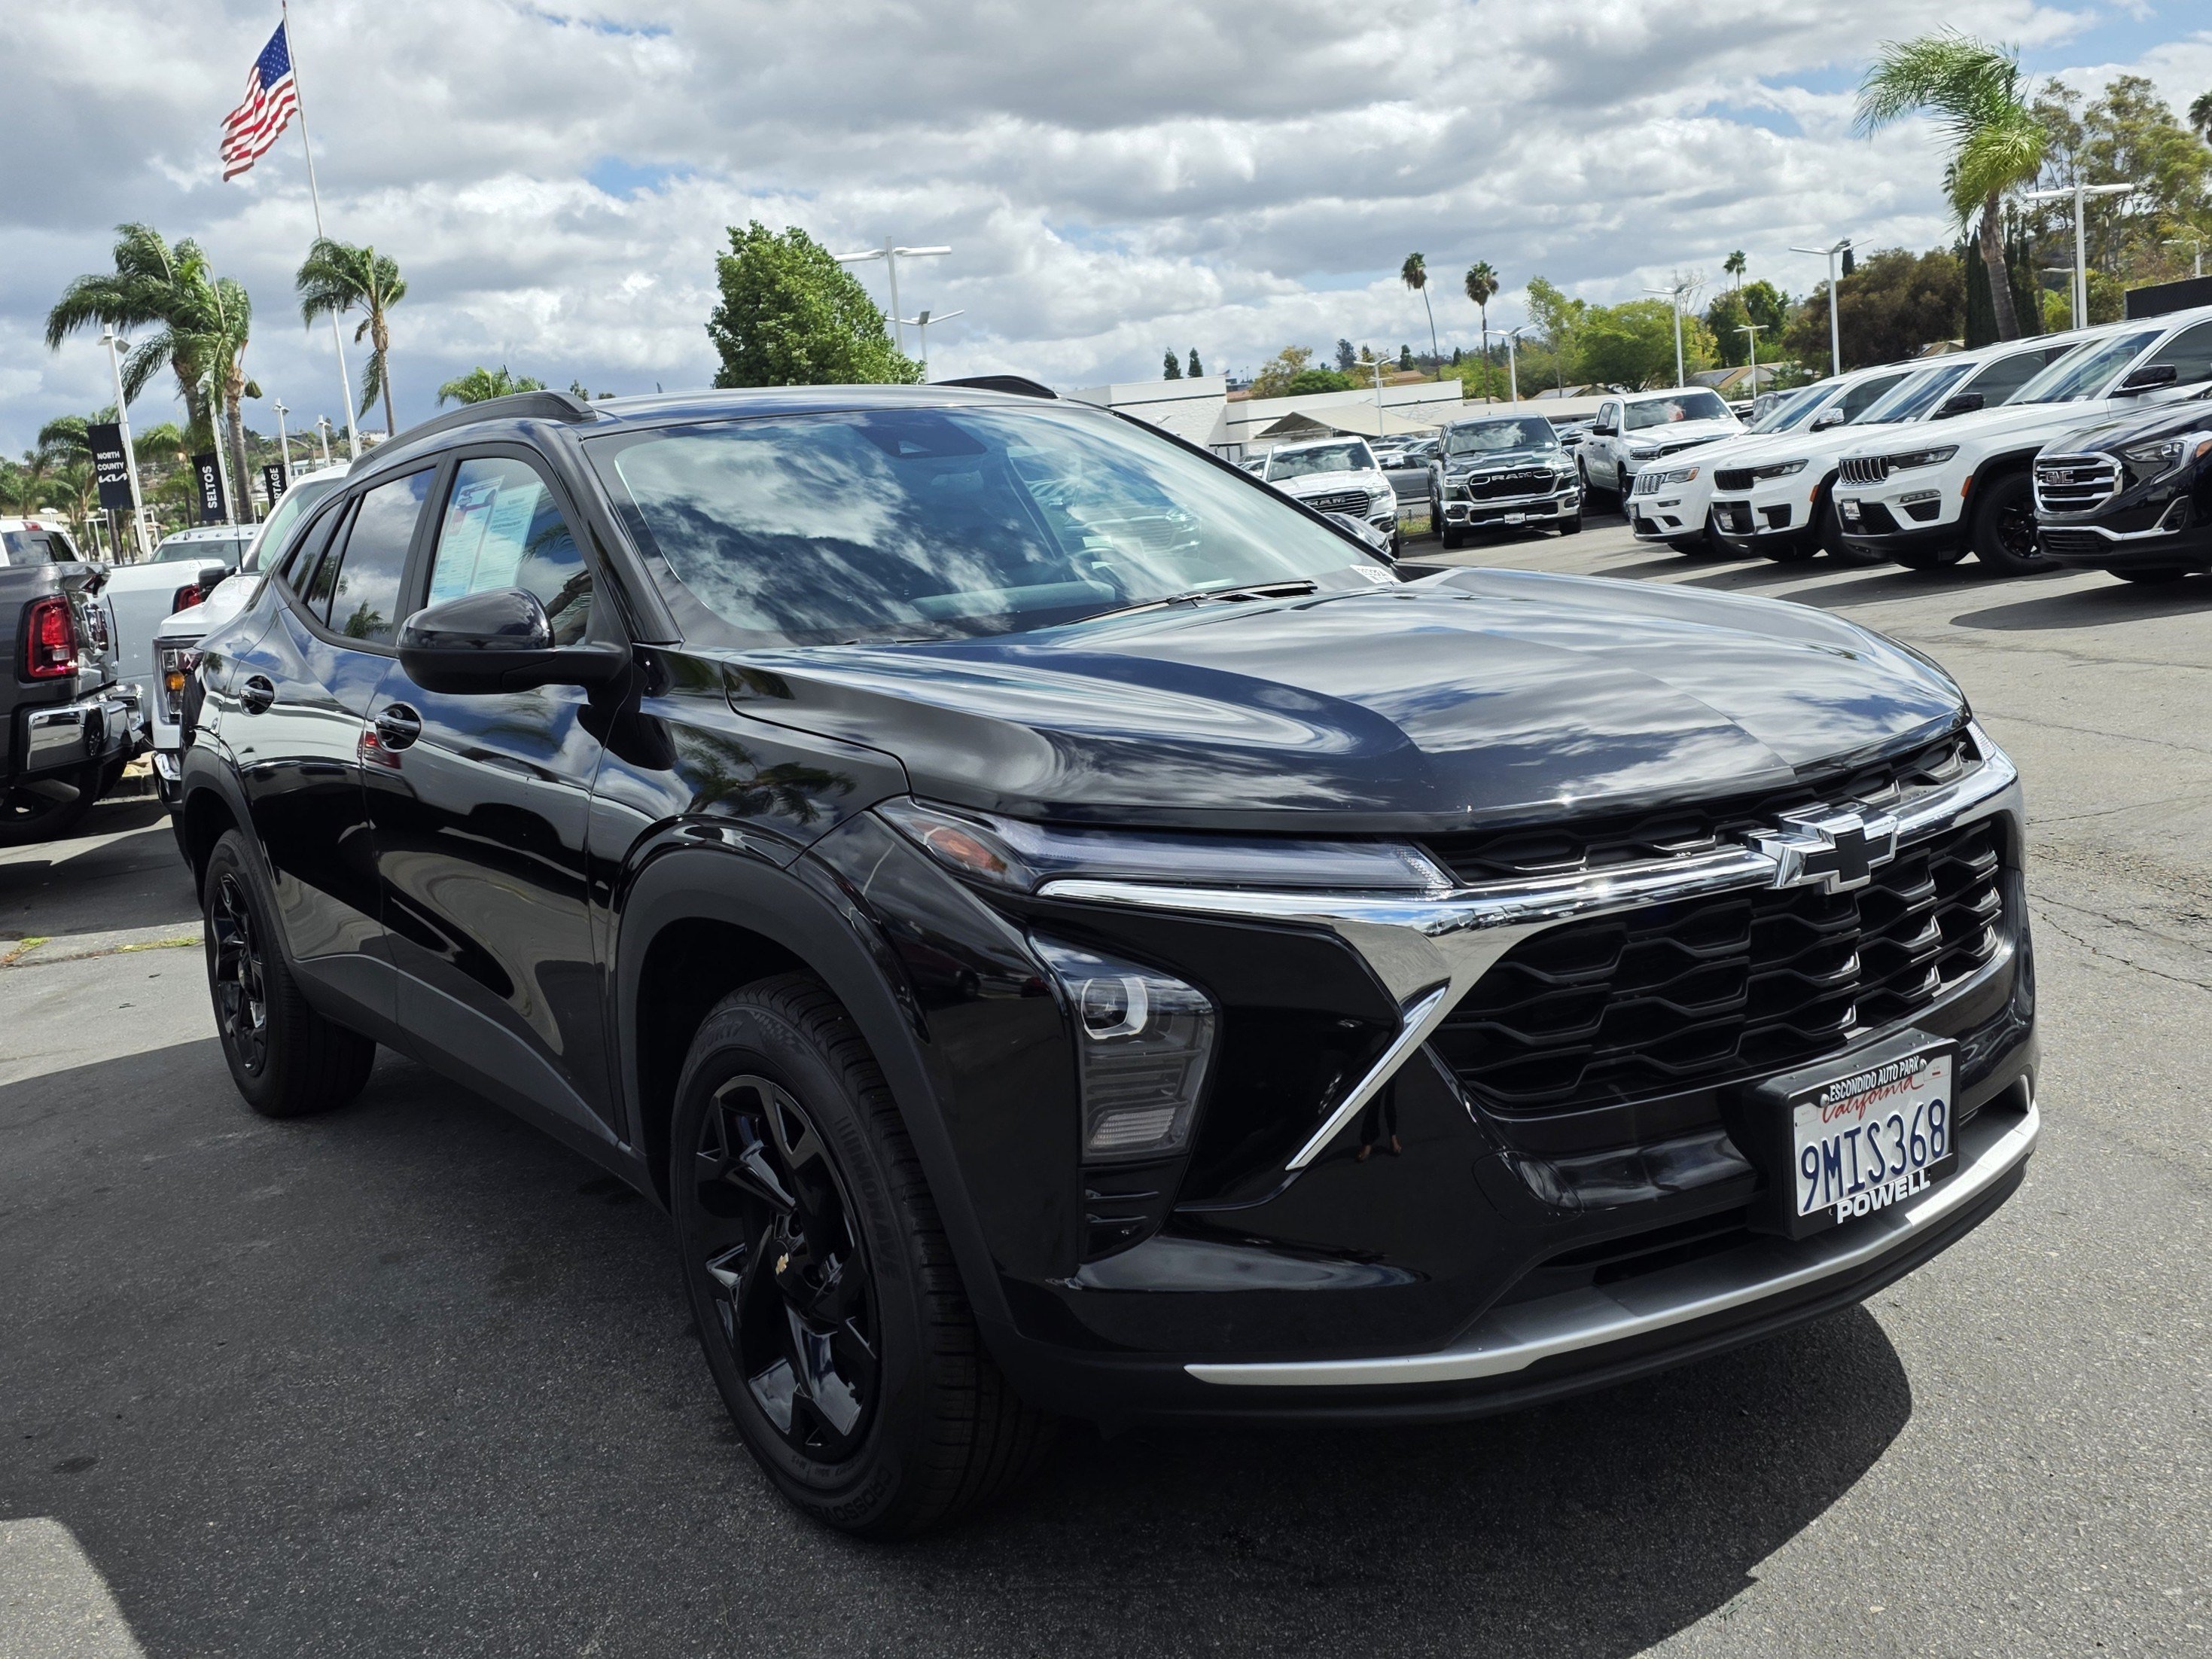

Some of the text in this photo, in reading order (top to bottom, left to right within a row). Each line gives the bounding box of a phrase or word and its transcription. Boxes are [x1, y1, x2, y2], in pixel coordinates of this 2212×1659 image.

[96, 451, 120, 460] NORTH
[97, 462, 124, 471] COUNTY
[1491, 471, 1533, 481] RAM
[202, 465, 218, 509] SELTOS
[270, 467, 282, 505] RTAGE
[2045, 470, 2075, 485] GMC
[1822, 1074, 1925, 1124] California
[1829, 1055, 1920, 1102] ESCONDIDO AUTO PARK
[1800, 1098, 1946, 1212] 9MIS368
[1836, 1169, 1931, 1224] POWELL
